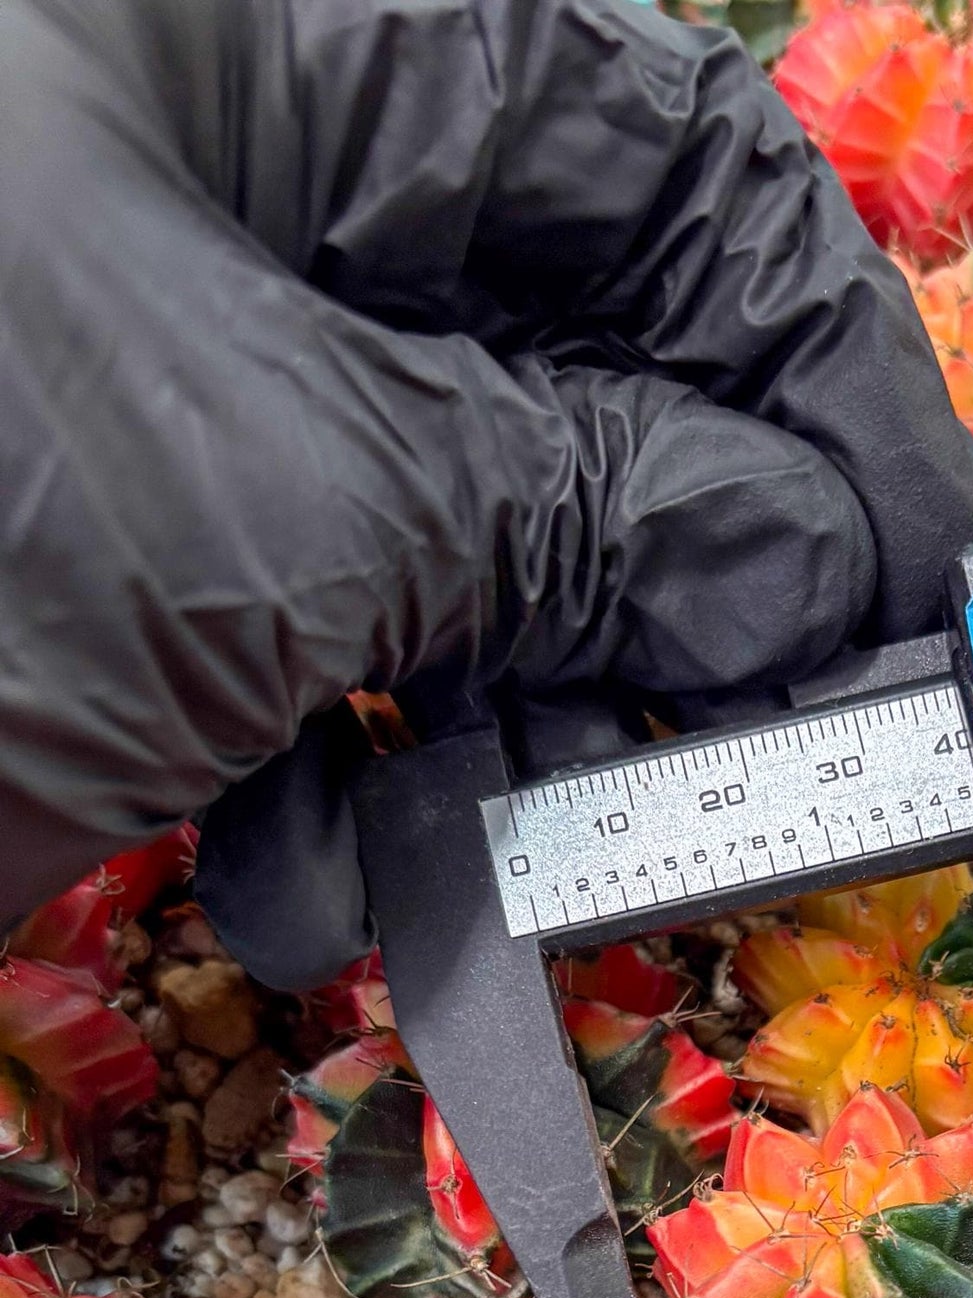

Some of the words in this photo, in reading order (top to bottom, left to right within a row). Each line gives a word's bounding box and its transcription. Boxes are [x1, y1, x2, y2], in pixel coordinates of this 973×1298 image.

[508, 854, 531, 877] 0
[593, 812, 629, 837] 10
[699, 783, 746, 813] 20
[816, 756, 863, 784] 30
[552, 884, 560, 897] 1
[575, 878, 590, 892] 2
[605, 870, 620, 884] 3
[636, 864, 648, 877] 4
[663, 856, 678, 871] 5
[693, 849, 708, 864] 6
[724, 842, 737, 856] 7
[751, 835, 767, 850] 8
[781, 828, 797, 844] 9
[808, 806, 821, 826] 1
[847, 815, 854, 827] 1
[869, 807, 885, 822] 2
[900, 800, 914, 813] 3
[930, 793, 942, 806] 4
[957, 786, 971, 800] 5
